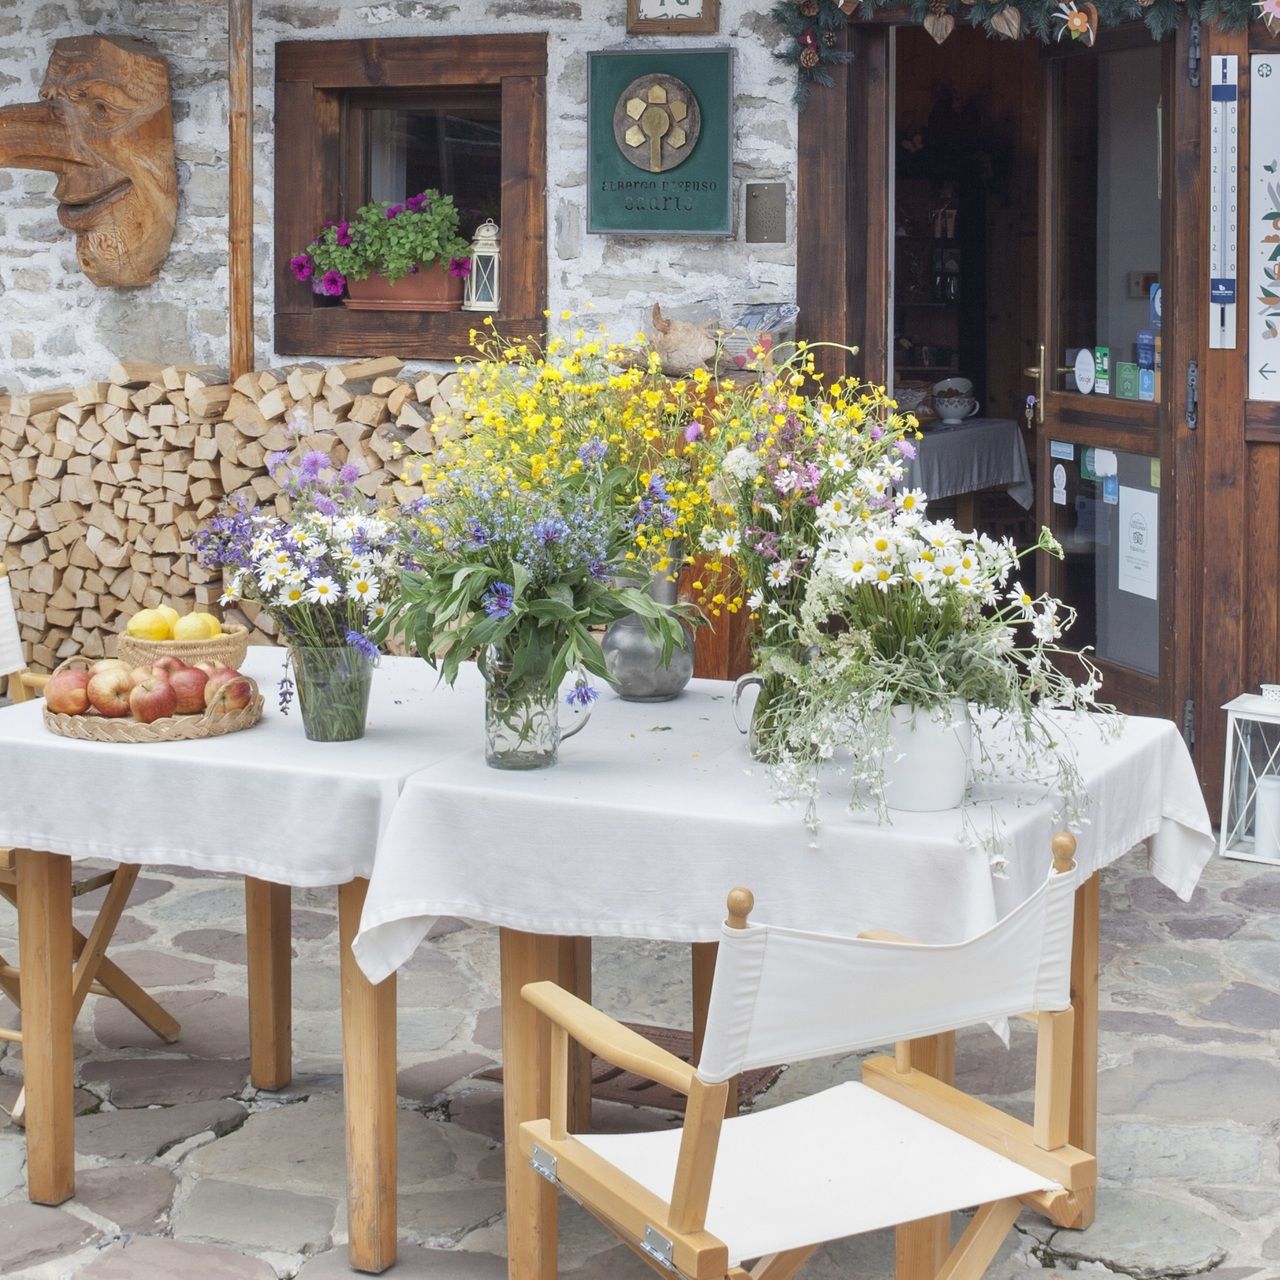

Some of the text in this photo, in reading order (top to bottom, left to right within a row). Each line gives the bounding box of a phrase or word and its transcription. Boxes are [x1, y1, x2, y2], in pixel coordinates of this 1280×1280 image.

[1231, 106, 1236, 114] 0
[1231, 126, 1236, 134] 0
[1231, 145, 1236, 153] 0
[1231, 165, 1236, 173] 0
[1231, 185, 1236, 193] 0
[1231, 205, 1236, 213] 0
[1231, 224, 1236, 232] 0
[1231, 244, 1236, 252] 0
[1231, 263, 1236, 271] 0
